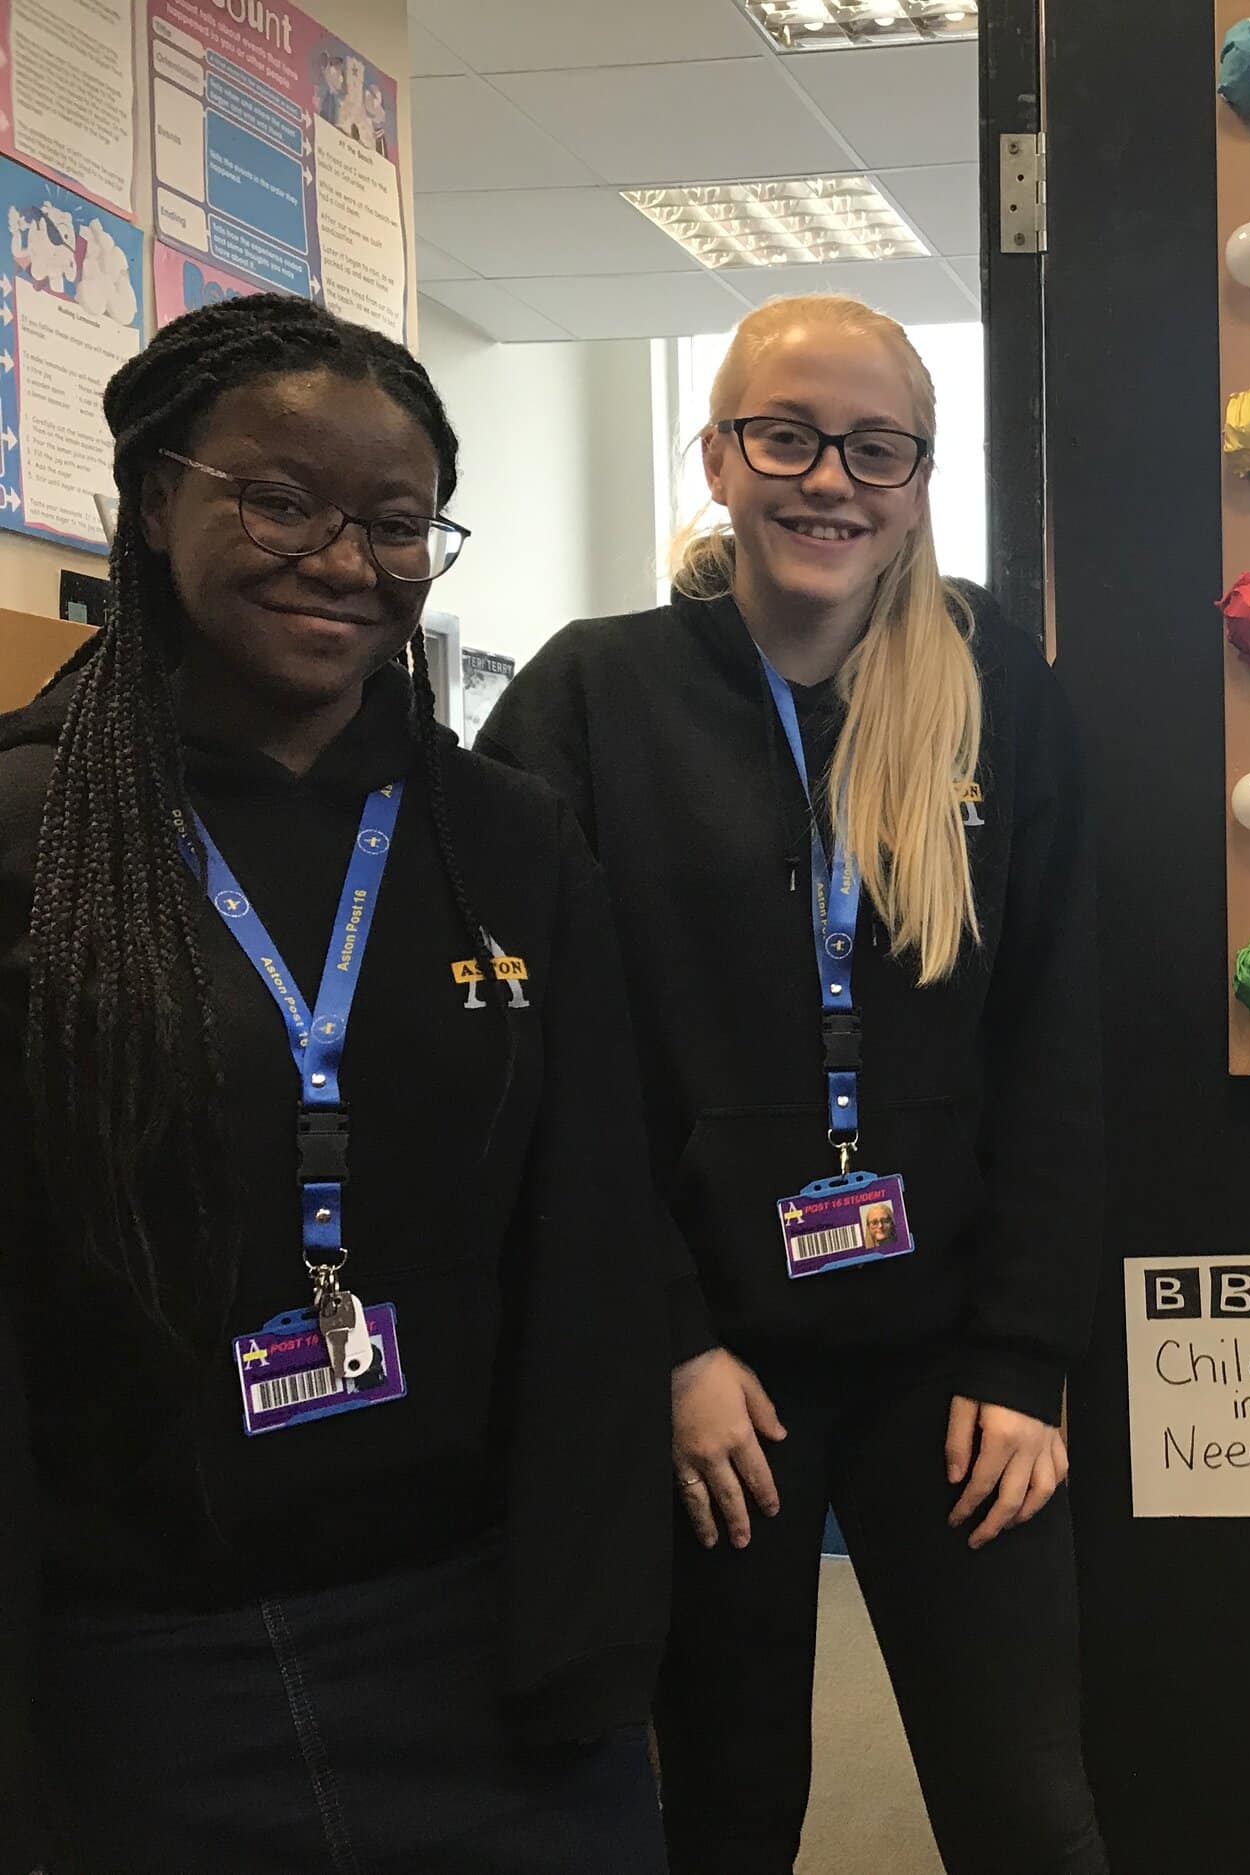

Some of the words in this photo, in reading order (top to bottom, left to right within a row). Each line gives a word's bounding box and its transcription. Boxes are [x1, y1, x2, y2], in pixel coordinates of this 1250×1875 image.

[487, 659, 512, 675] TERRY
[353, 889, 367, 902] 16
[345, 906, 364, 931] Post
[336, 933, 357, 972] Aston
[260, 956, 289, 994] Aston
[283, 996, 304, 1028] Post
[804, 1201, 829, 1214] POST
[843, 1189, 886, 1205] STUDENT
[270, 1337, 303, 1355] POST
